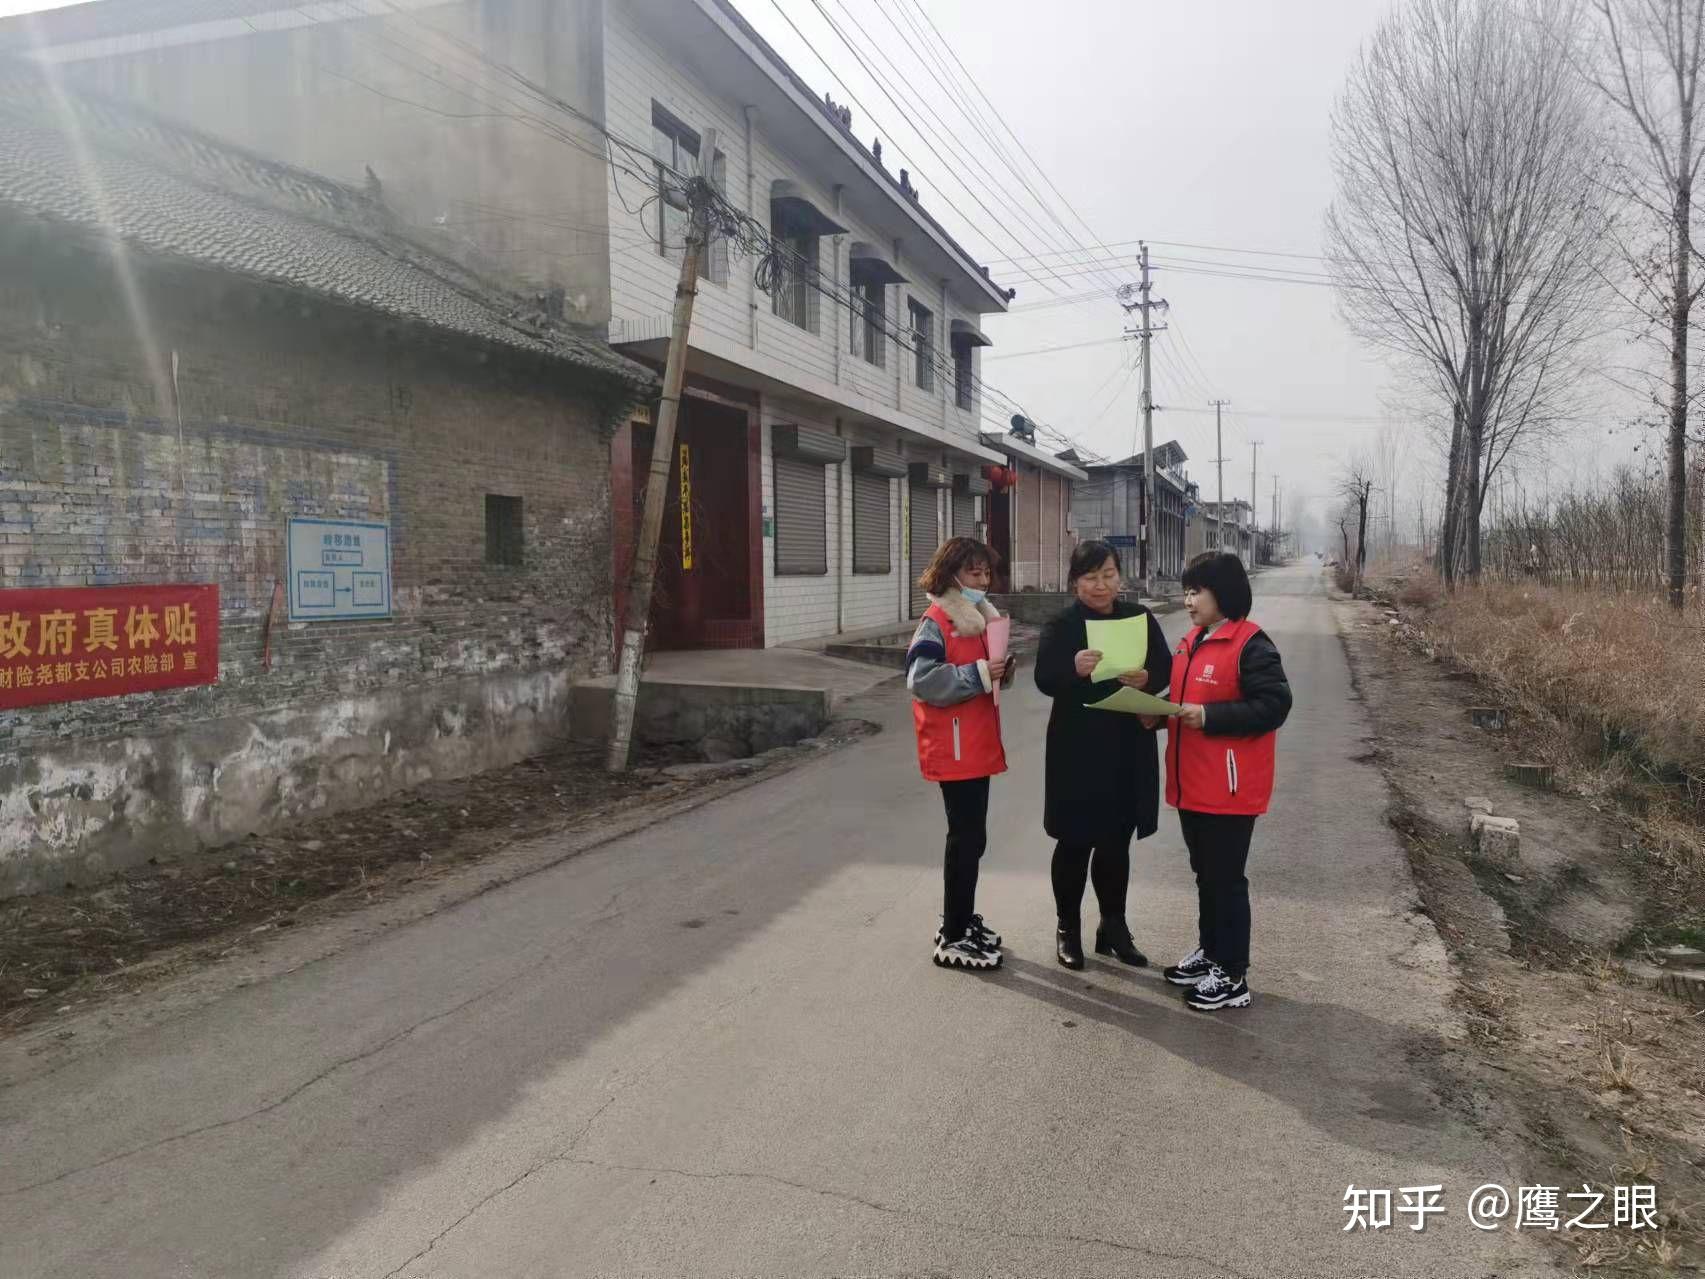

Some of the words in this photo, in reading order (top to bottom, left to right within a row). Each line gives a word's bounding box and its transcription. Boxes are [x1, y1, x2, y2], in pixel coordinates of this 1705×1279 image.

[0, 603, 197, 659] 政府真体贴
[183, 651, 197, 670] 宣
